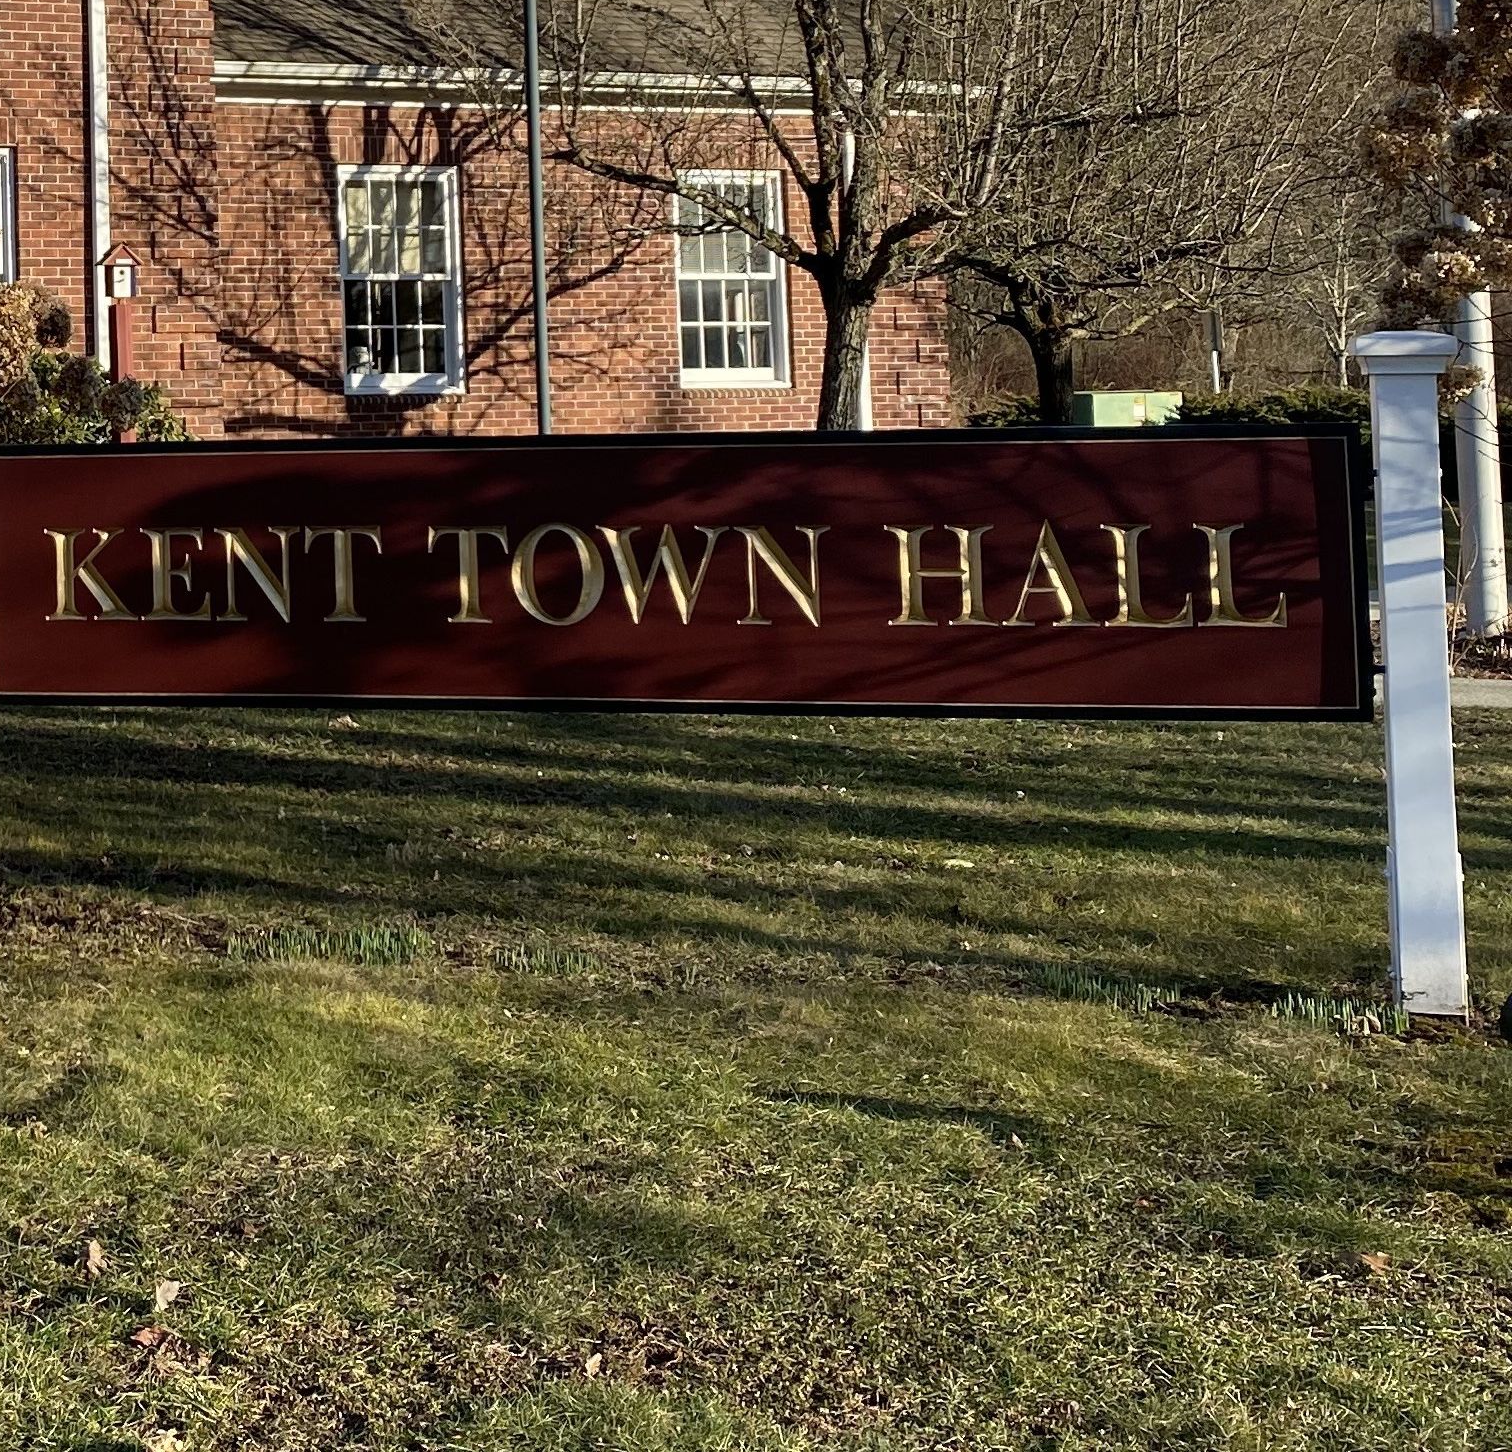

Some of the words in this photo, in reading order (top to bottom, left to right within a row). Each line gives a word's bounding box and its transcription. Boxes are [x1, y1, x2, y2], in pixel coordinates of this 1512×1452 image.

[43, 524, 383, 624] KENT
[427, 522, 831, 628] TOWN
[883, 518, 1288, 628] HALL
